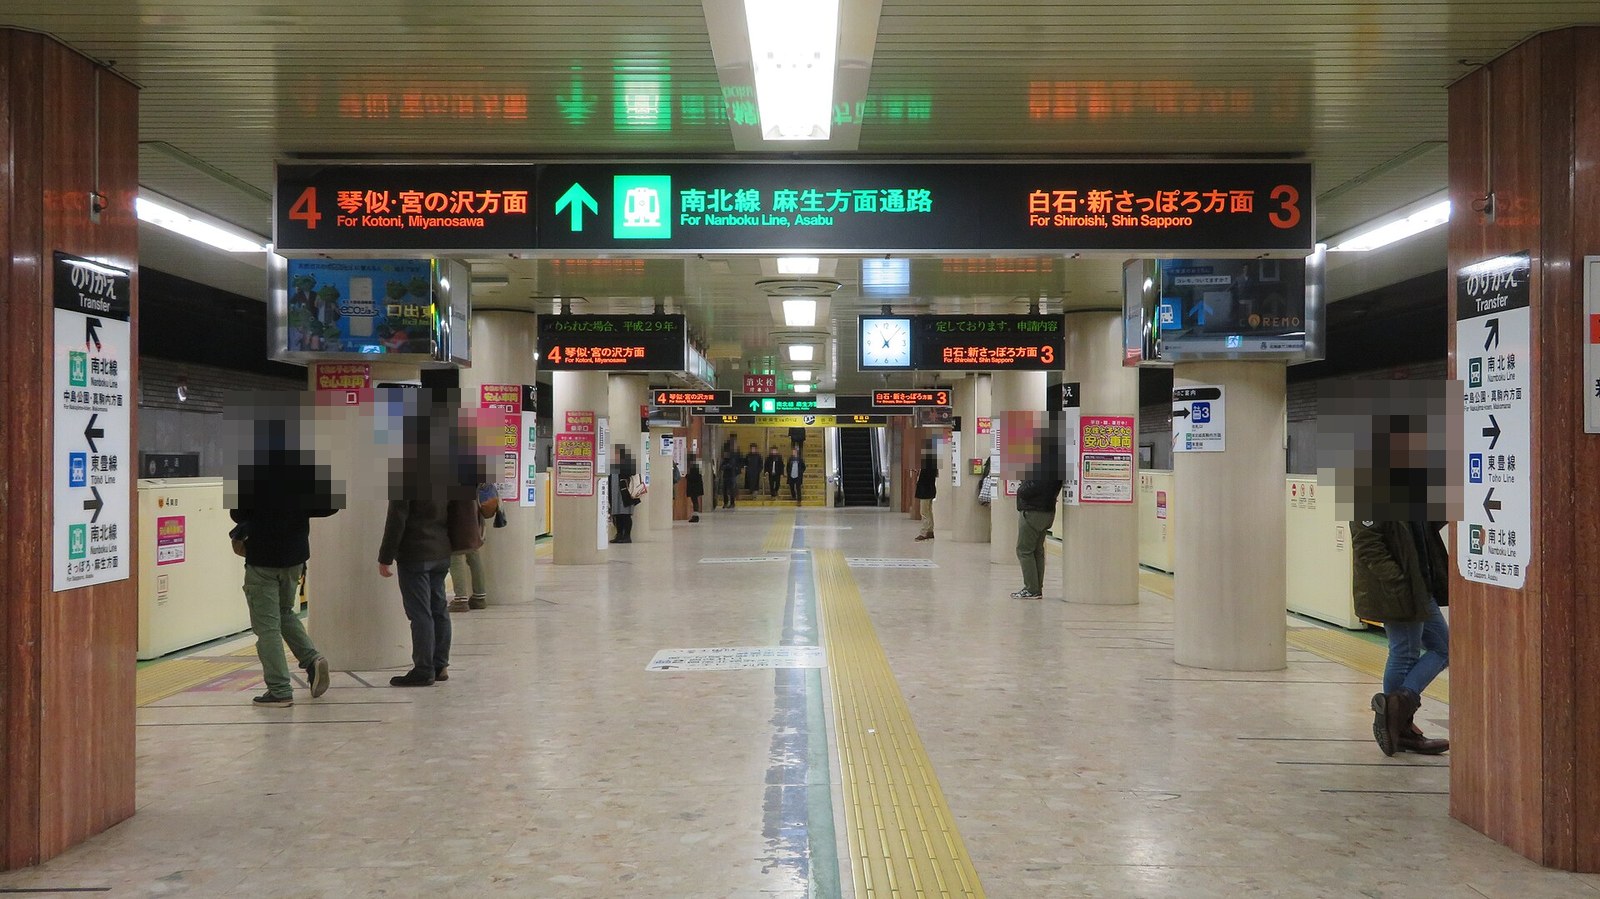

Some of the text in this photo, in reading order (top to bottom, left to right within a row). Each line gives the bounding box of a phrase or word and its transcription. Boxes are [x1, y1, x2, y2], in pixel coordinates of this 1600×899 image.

[289, 186, 322, 230] 4
[337, 190, 528, 214] 琴似・宮の沢方面
[680, 188, 933, 213] 南北線 麻生方面通路
[1028, 189, 1255, 214] 白石・新さっぽろ方面
[1268, 184, 1301, 230] 3
[337, 215, 484, 229] For Kotoni, Miyanosawa
[680, 214, 833, 228] For Nanboku Line, Asabu
[1029, 214, 1192, 229] For Shiroishi, Shin Sapporo
[79, 292, 110, 312] Transfer
[1475, 293, 1509, 312] Transfer
[547, 345, 562, 364] 4
[565, 347, 645, 358] 琴似・宮の沢方面
[943, 346, 1038, 358] 白石・新さっぽろ方面
[1040, 345, 1055, 364] 3
[91, 357, 118, 376] 南北線
[1487, 353, 1516, 372] 南北線
[657, 392, 667, 404] 4
[937, 391, 947, 405] 3
[1201, 406, 1210, 419] 3
[1084, 434, 1132, 449] 安心車両
[91, 455, 118, 472] 東豊線
[1487, 454, 1516, 471] 東豊線
[105, 475, 116, 484] Line
[1503, 473, 1515, 483] Line
[91, 523, 118, 542] 南北線
[1488, 528, 1517, 547] 南北線
[67, 556, 119, 575] さっぽろ・麻生方面
[1466, 558, 1520, 578] さっぽろ・麻生方面
